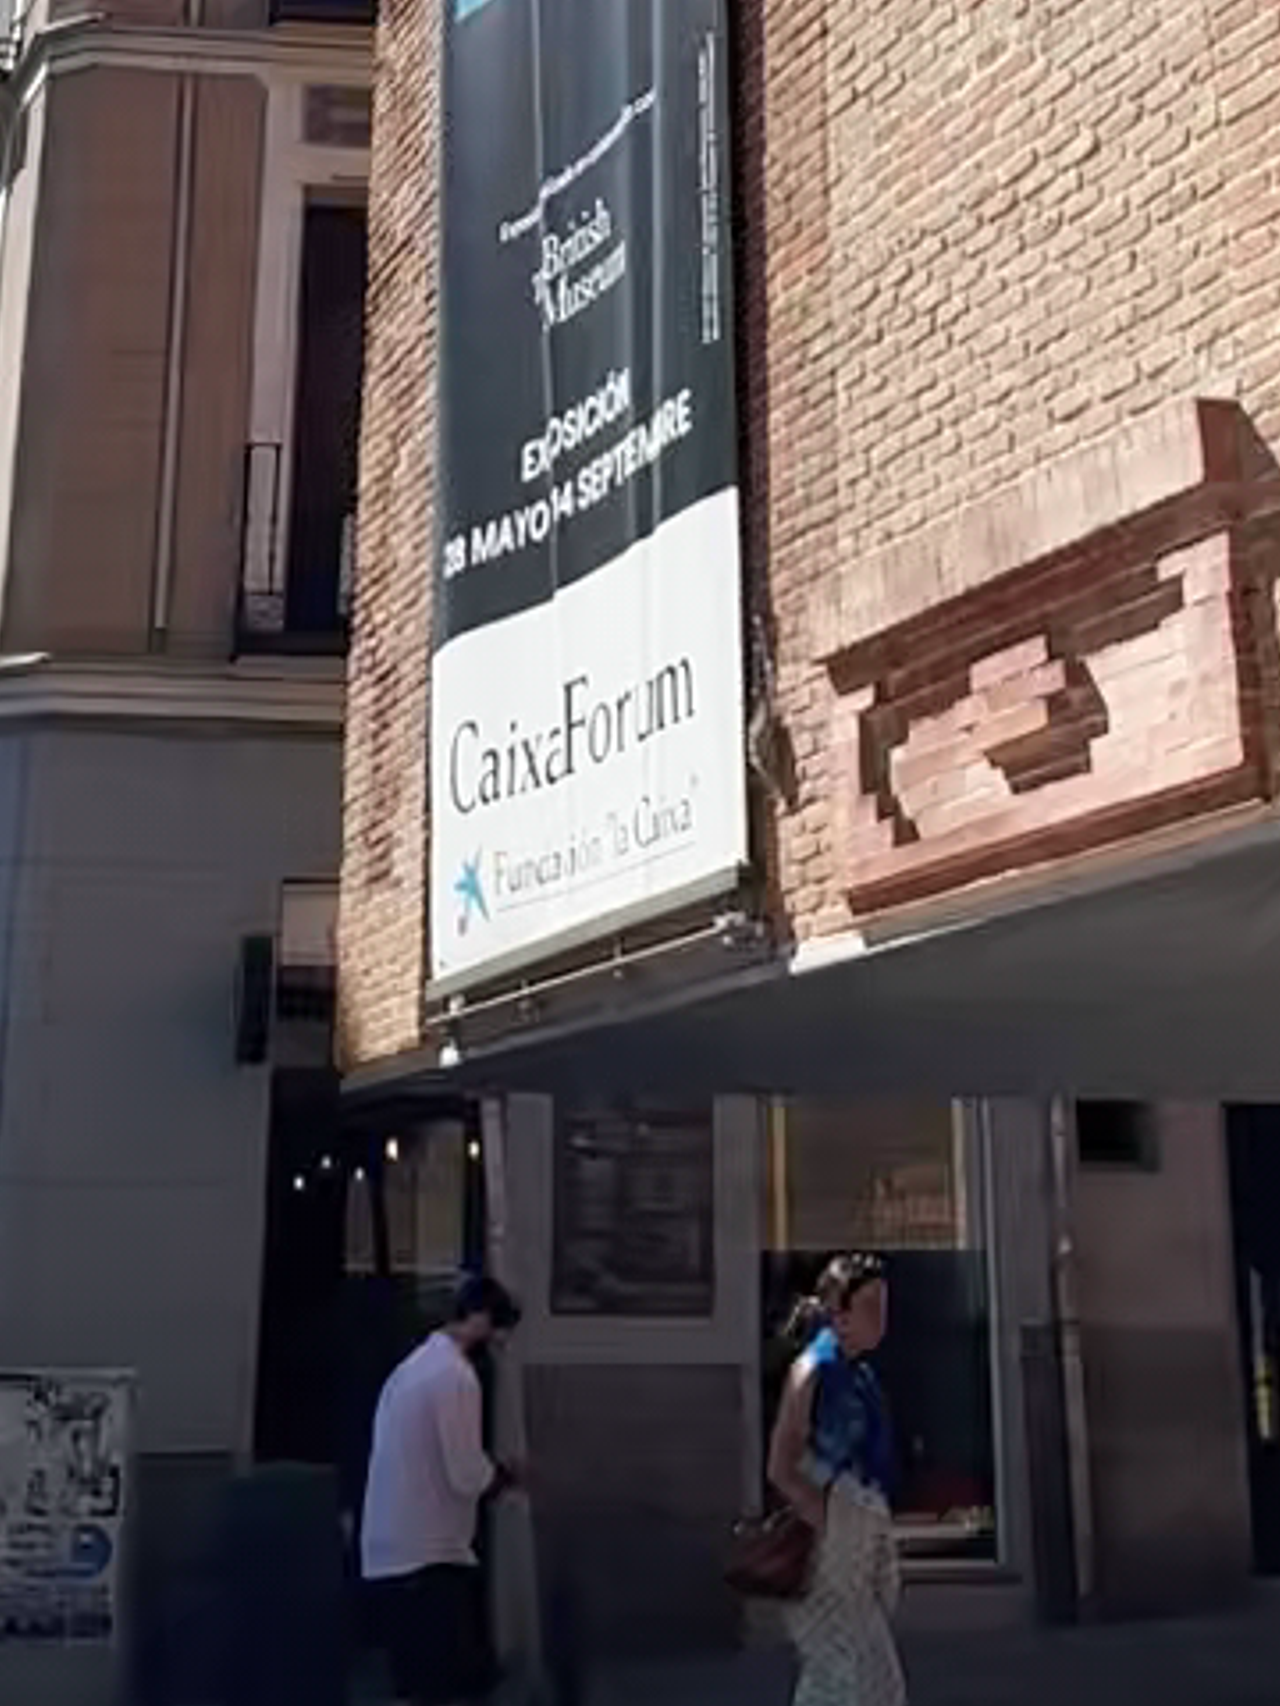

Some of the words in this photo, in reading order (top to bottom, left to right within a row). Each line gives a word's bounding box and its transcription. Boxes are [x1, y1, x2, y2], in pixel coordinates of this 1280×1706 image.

[542, 198, 611, 281] British
[532, 241, 626, 326] Museum
[470, 499, 551, 566] MAYO
[450, 657, 694, 815] CaixaForum
